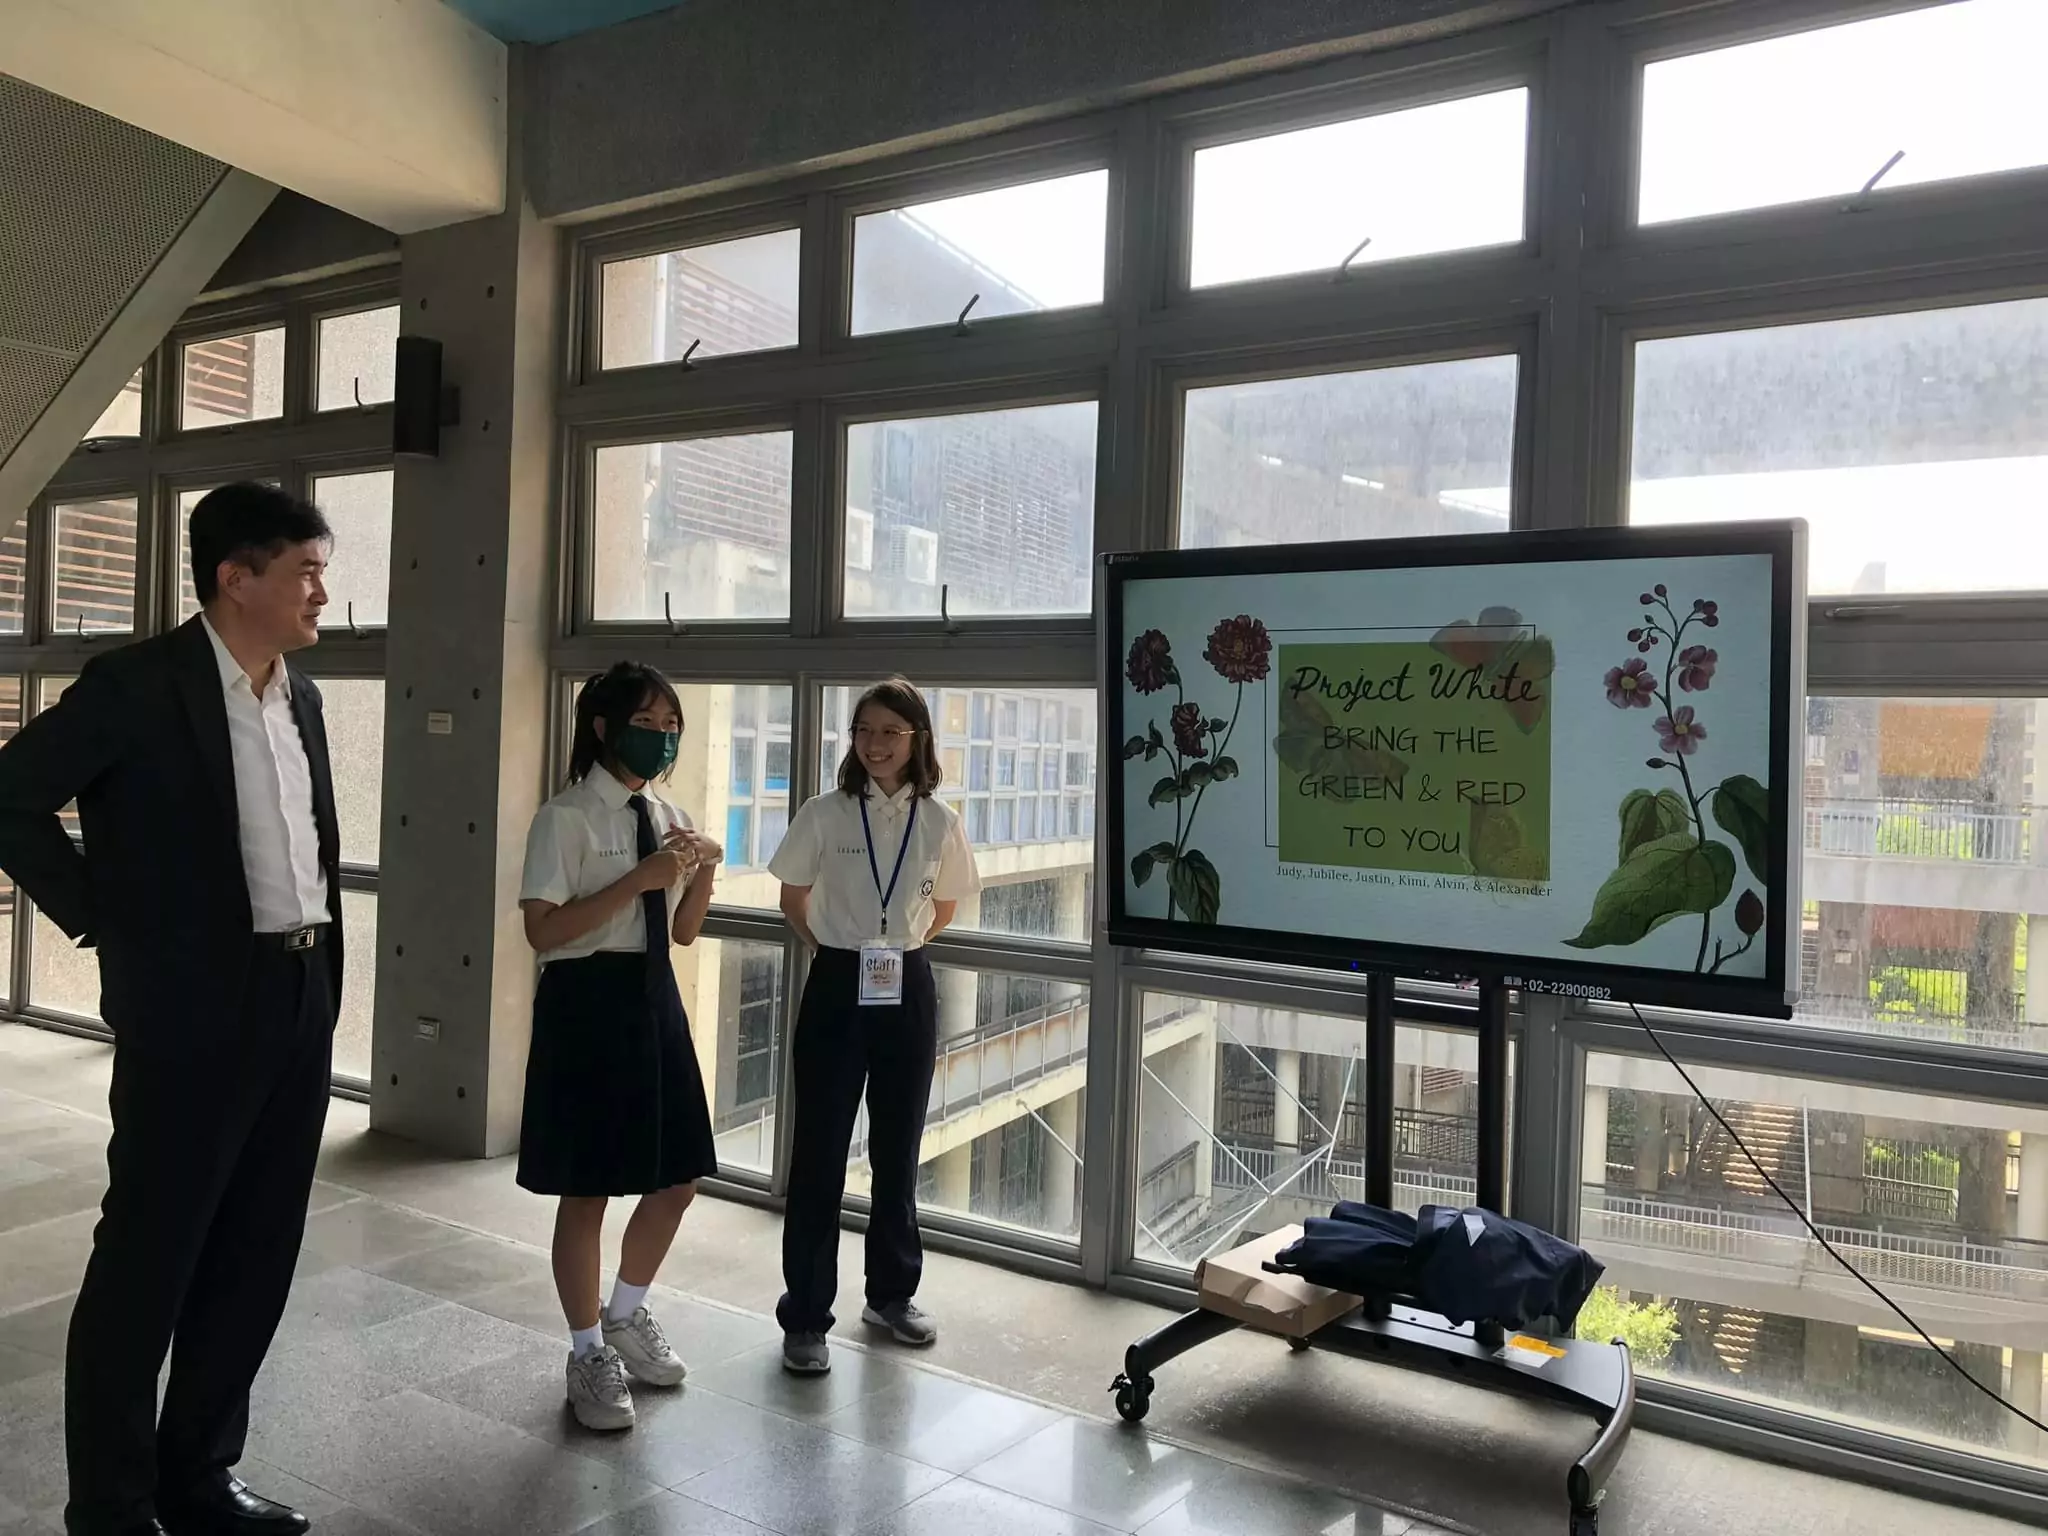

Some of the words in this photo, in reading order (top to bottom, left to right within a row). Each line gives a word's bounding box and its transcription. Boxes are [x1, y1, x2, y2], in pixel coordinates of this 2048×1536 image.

[1290, 661, 1416, 713] Project
[1428, 661, 1541, 702] White
[1323, 725, 1418, 754] BRING
[1433, 726, 1499, 754] THE
[1299, 773, 1404, 801] GREEN
[1417, 773, 1441, 802] &
[1456, 779, 1526, 806] RED
[1343, 826, 1387, 849] TO
[1400, 827, 1461, 854] YOU
[1276, 865, 1305, 880] Judy,
[1307, 868, 1353, 882] Jubilee,
[1355, 871, 1395, 885] Justin,
[1398, 874, 1430, 887] Kimi,
[1434, 877, 1469, 892] Alvin,
[1473, 879, 1482, 891] &
[1486, 881, 1553, 897] Alexander
